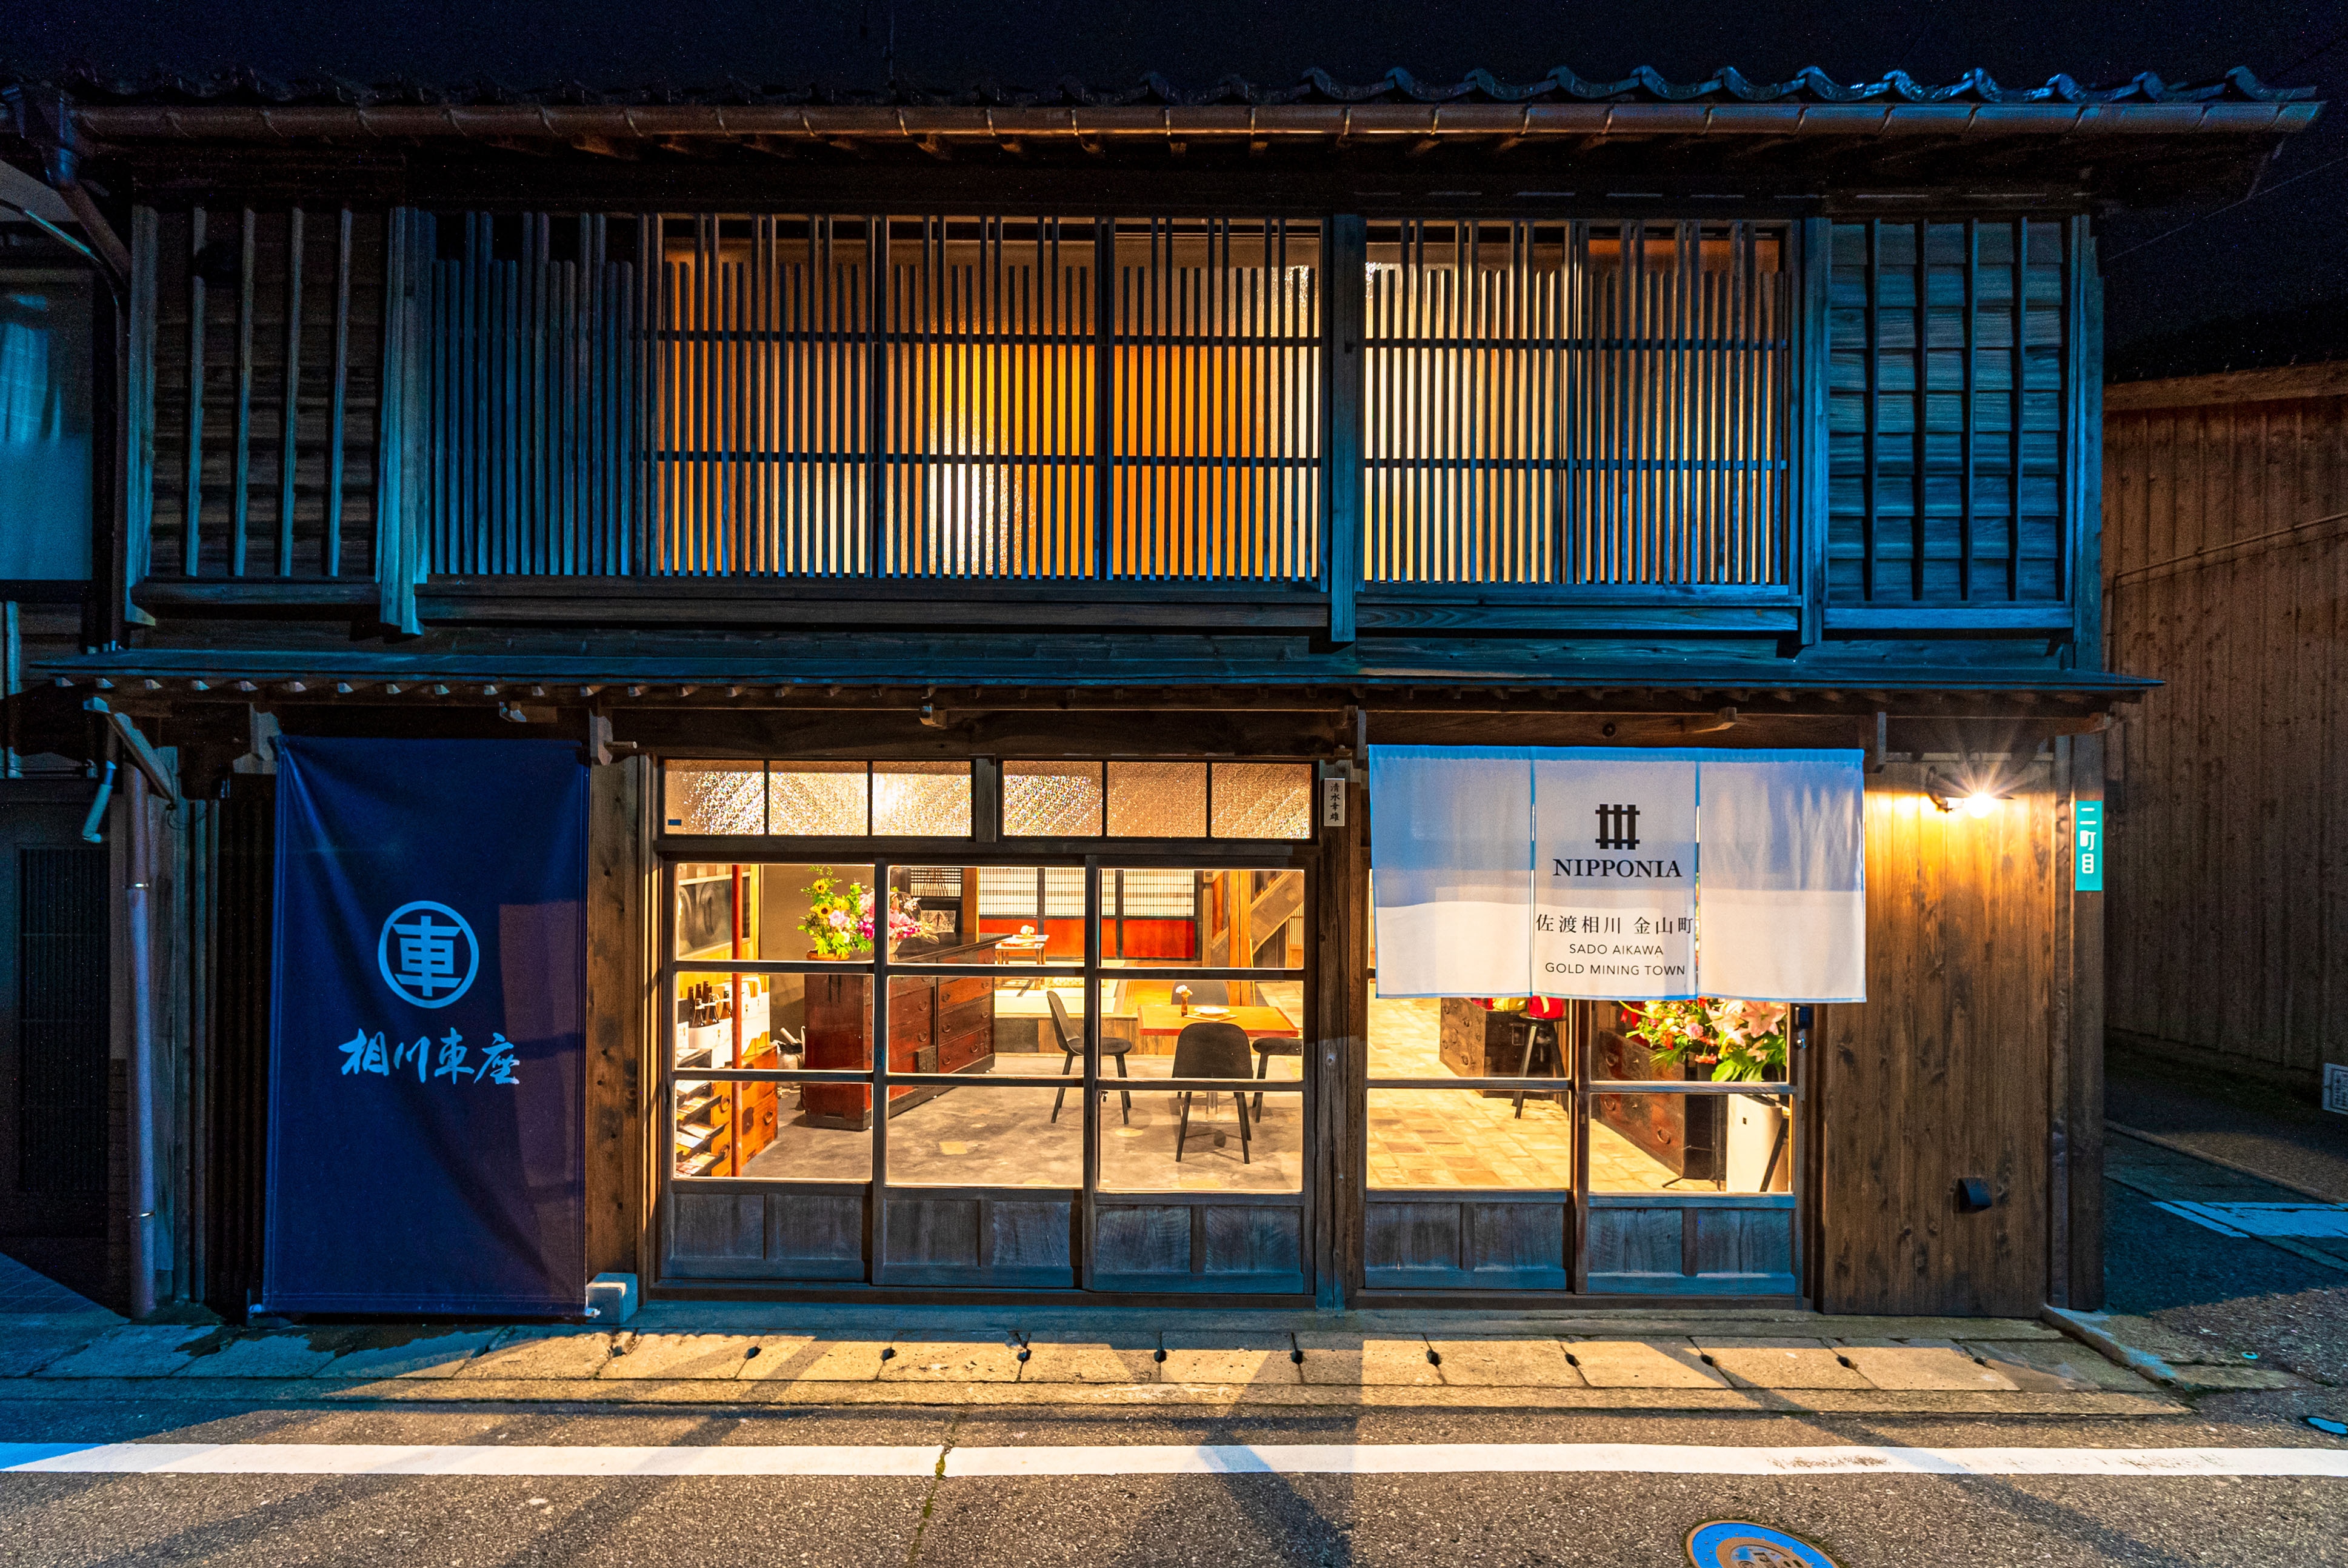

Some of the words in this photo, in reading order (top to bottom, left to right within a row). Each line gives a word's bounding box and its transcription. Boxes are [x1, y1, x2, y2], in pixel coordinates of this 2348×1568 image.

[2080, 807, 2097, 874] 二町目
[1553, 859, 1683, 878] NIPPONIA
[1536, 914, 1621, 934] 佐渡相川
[1633, 916, 1693, 935] 金山町
[391, 914, 464, 997] 車
[1569, 943, 1607, 955] SADO
[1612, 944, 1664, 955] AIKAWA
[1545, 962, 1584, 974] GOLD
[1590, 964, 1639, 975] MINING
[1644, 965, 1686, 976] TOWN
[338, 1027, 520, 1085] 相川車座
